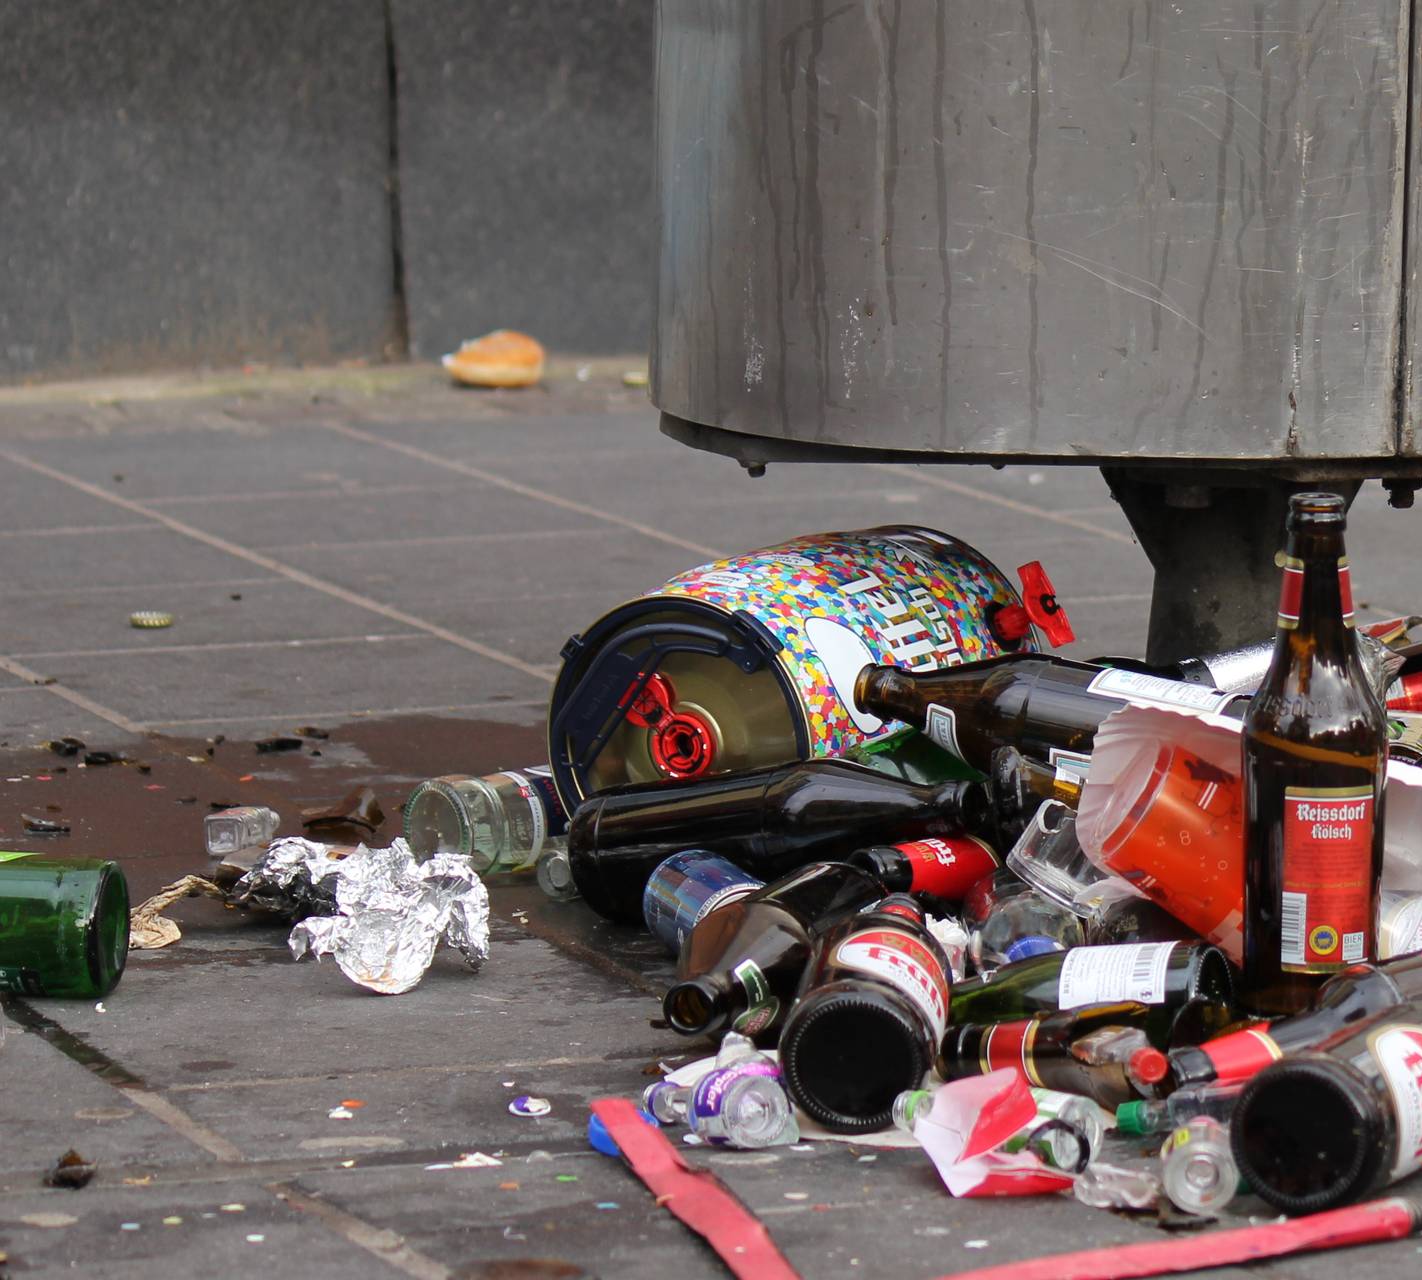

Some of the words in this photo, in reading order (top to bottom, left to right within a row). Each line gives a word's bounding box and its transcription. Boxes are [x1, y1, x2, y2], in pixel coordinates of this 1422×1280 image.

[838, 569, 938, 673] ffel
[1297, 802, 1365, 822] Reissdorf
[1312, 824, 1352, 840] Kölsch
[1344, 935, 1362, 944] BIER
